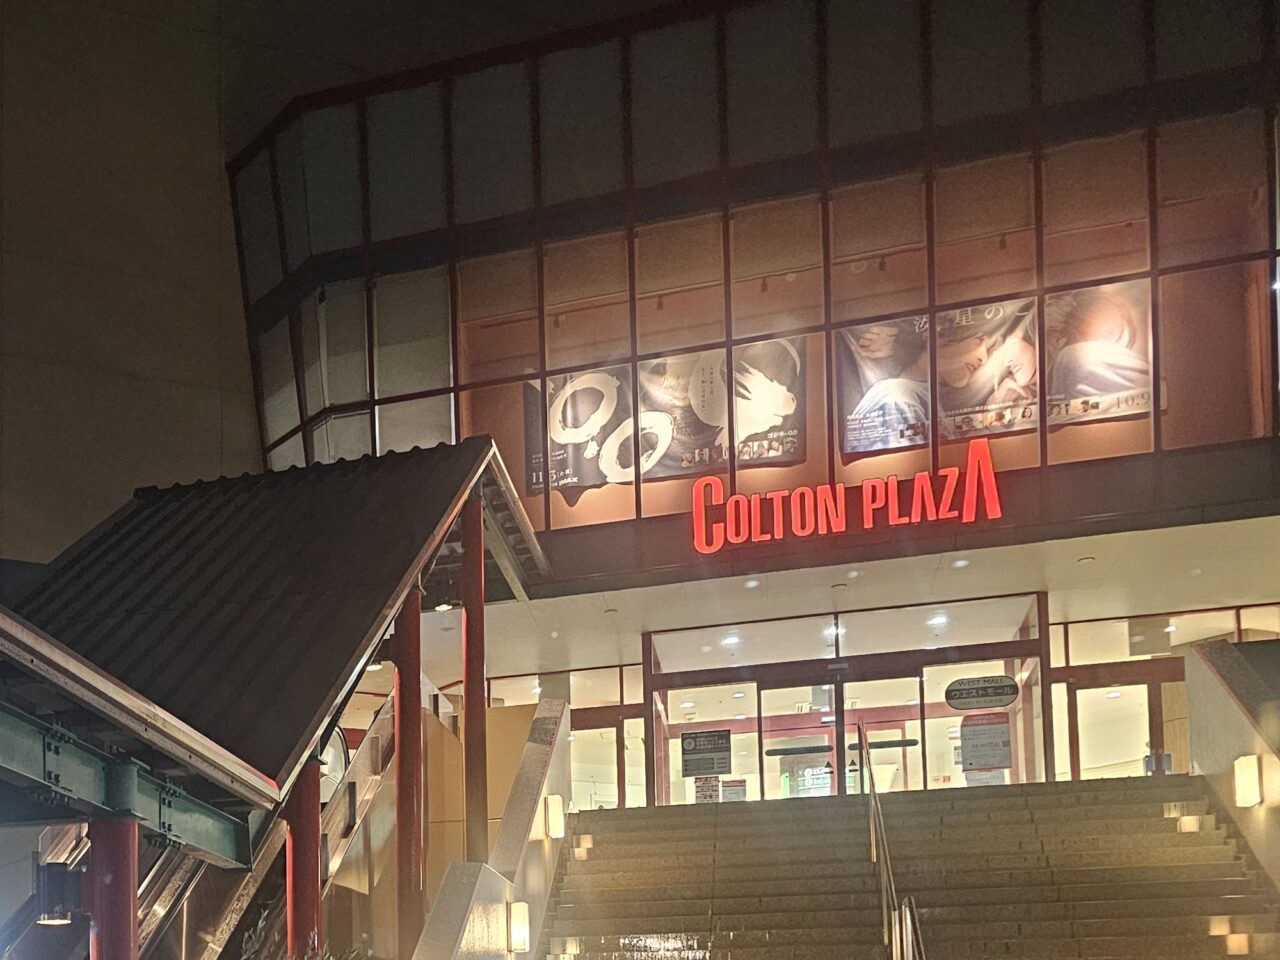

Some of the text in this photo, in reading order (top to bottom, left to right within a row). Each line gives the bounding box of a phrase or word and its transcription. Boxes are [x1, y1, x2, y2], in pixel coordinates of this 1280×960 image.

[691, 437, 1002, 555] COLTON PLAZA
[951, 687, 1014, 698] ウエストモール
